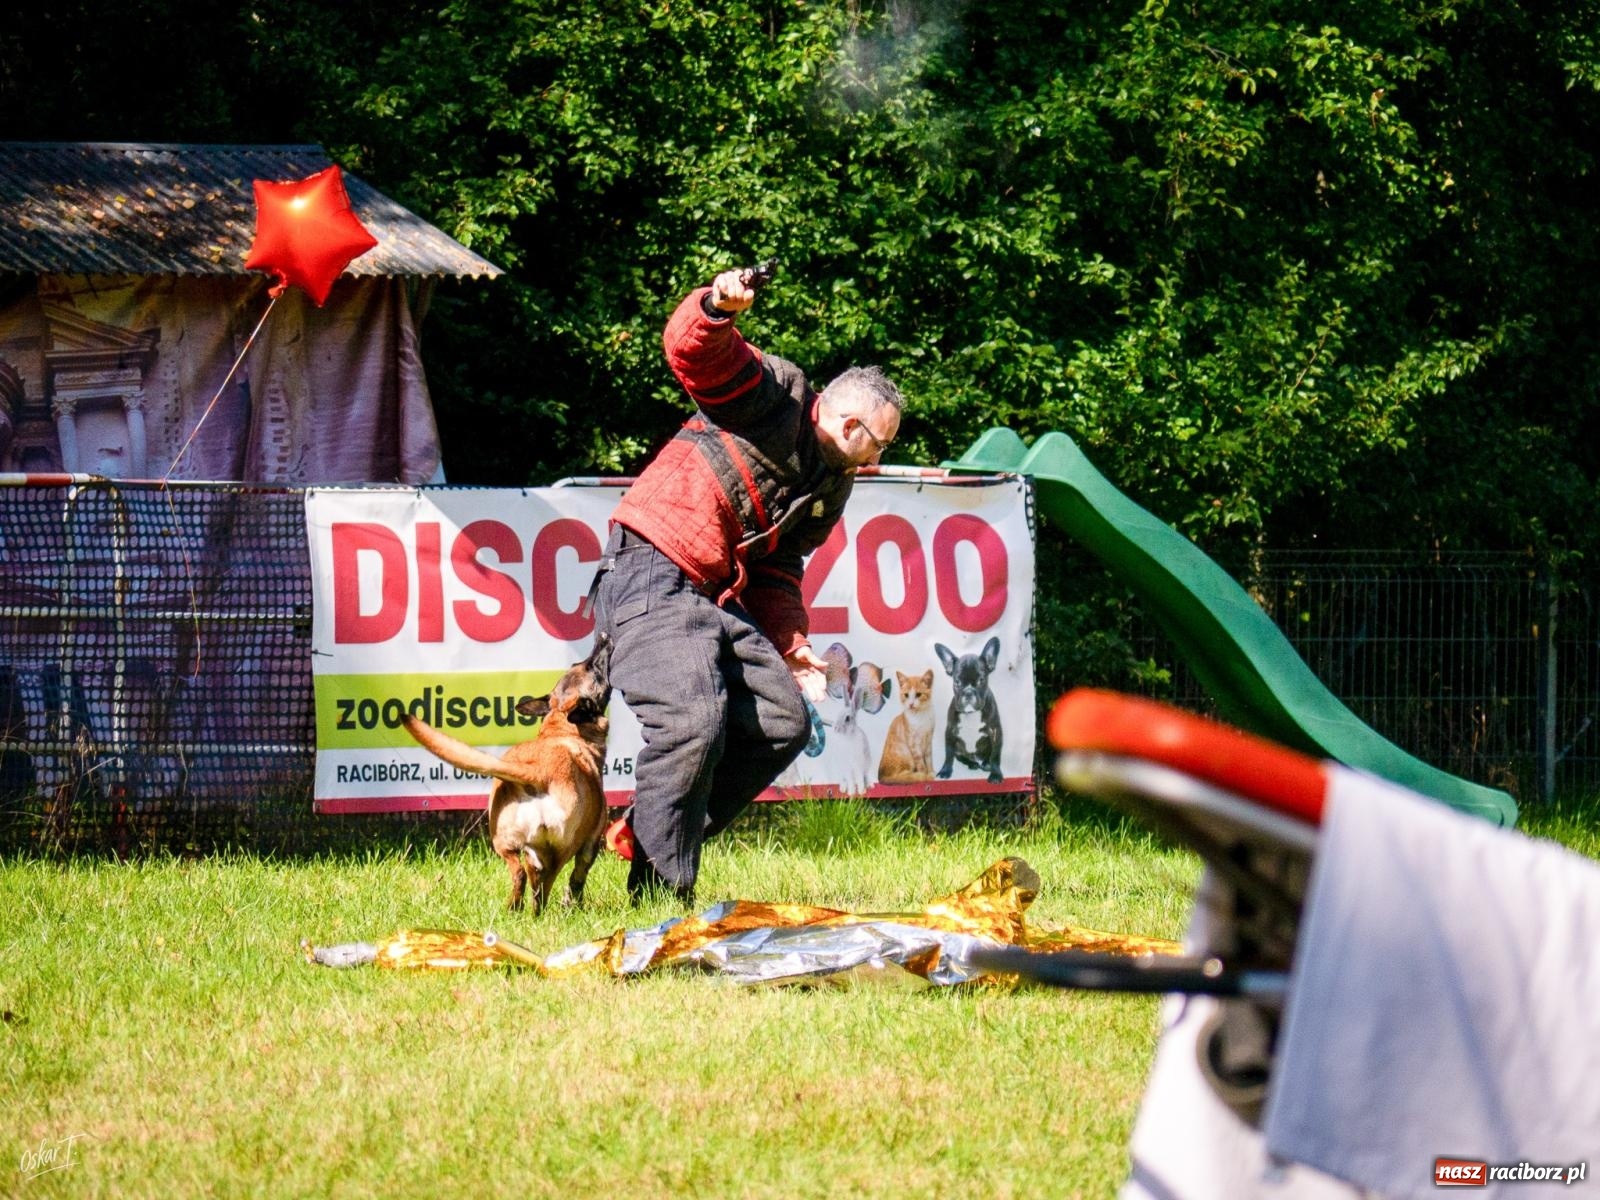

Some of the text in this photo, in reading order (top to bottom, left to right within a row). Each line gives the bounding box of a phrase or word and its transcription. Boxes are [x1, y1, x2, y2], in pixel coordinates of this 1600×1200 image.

[331, 517, 604, 644] DISC
[336, 760, 425, 783] RACIBÓRZ,
[429, 762, 448, 780] ul.
[612, 757, 633, 775] 45
